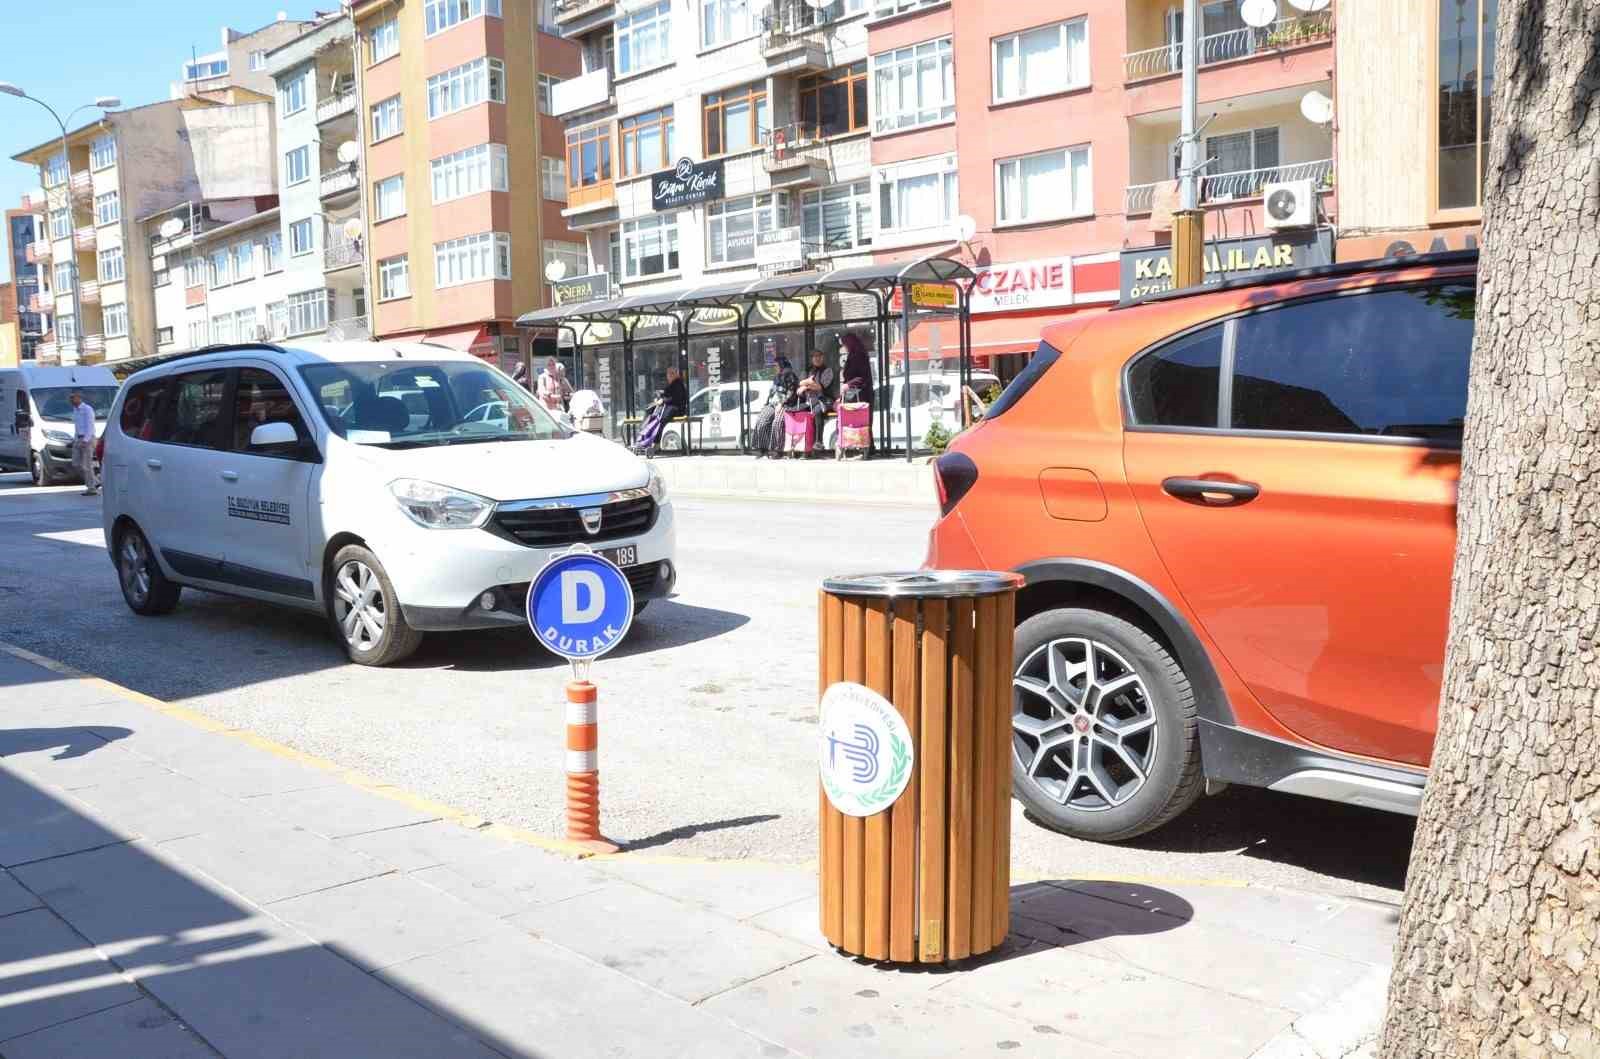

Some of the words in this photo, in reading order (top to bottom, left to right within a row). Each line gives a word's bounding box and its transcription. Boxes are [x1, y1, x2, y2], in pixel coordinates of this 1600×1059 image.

[616, 546, 635, 566] 189
[561, 570, 606, 625] D
[543, 624, 619, 652] DURAK
